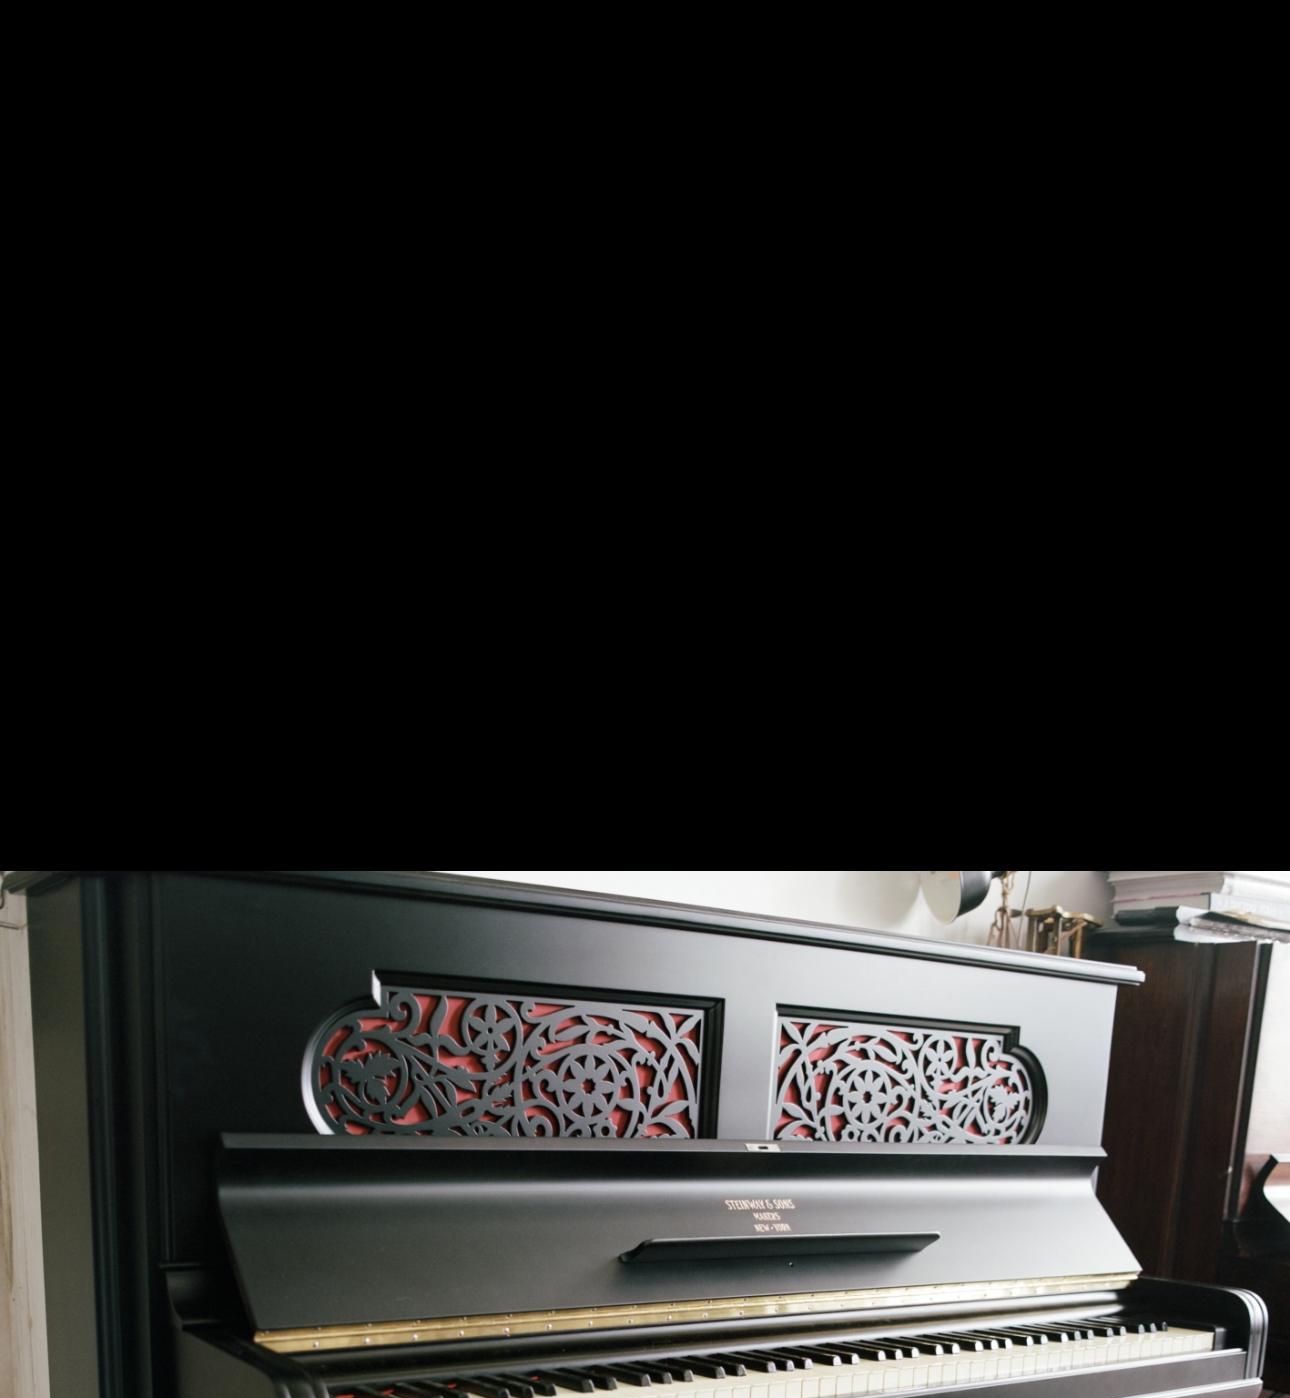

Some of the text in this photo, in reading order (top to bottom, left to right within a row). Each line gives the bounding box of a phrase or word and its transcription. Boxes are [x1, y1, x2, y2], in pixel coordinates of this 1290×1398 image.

[725, 1199, 796, 1210] STEINWAY & SONS
[752, 1212, 781, 1221] MAKERS
